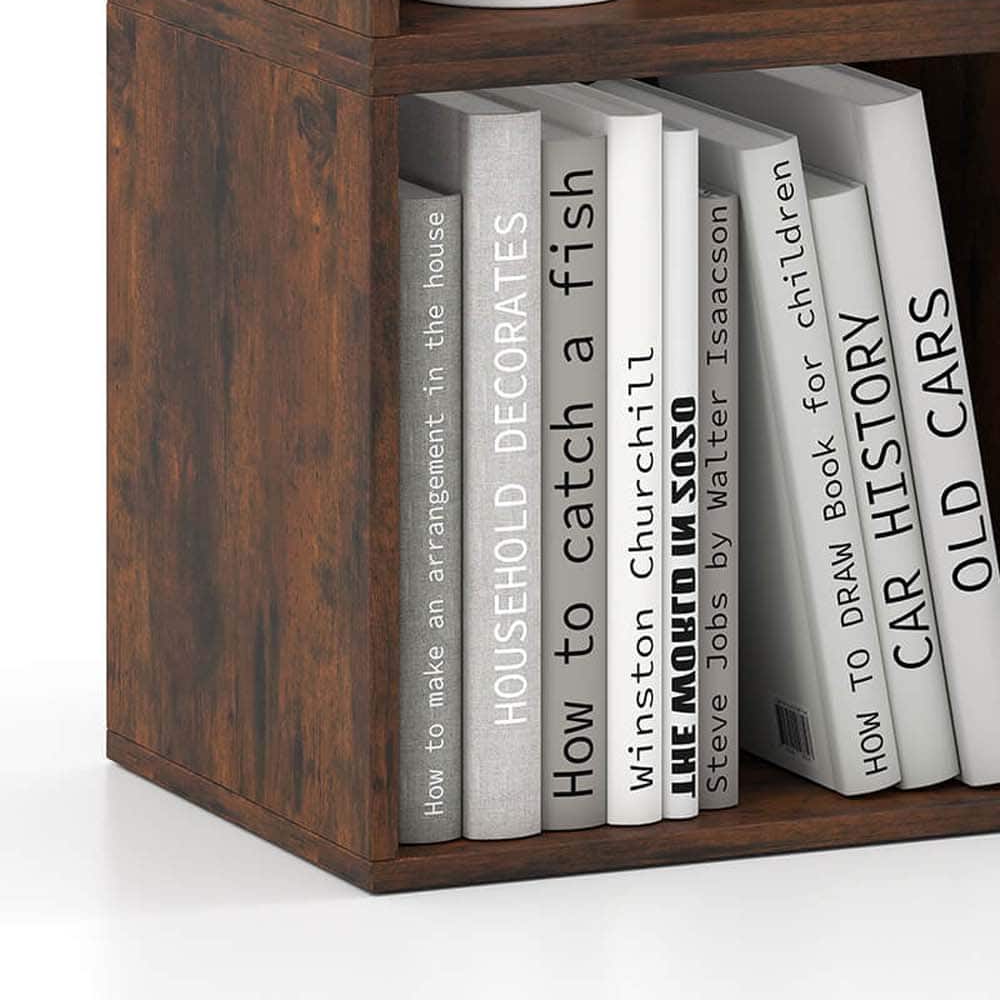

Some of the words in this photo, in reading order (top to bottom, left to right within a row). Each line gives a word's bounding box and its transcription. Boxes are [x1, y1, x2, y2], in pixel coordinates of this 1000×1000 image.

[423, 212, 444, 289] house
[550, 170, 594, 296] fish
[773, 160, 815, 328] children
[423, 304, 444, 349] the
[706, 206, 728, 365] Isaacson
[494, 211, 528, 453] DECORATES
[563, 336, 594, 362] a
[909, 288, 968, 438] CARS
[423, 366, 444, 396] in
[802, 355, 828, 413] for
[839, 312, 914, 539] HISTORY
[550, 402, 594, 563] catch
[628, 347, 654, 579] Churchill
[705, 390, 728, 510] Walter
[812, 435, 846, 521] Book
[424, 413, 448, 582] arrangement
[940, 479, 993, 592] OLD
[704, 532, 732, 569] by
[828, 543, 864, 627] DRAW
[428, 599, 444, 629] an
[494, 483, 528, 725] HOUSEHOLD
[554, 603, 593, 664] to
[705, 593, 728, 669] Jobs
[883, 569, 933, 669] CAR
[423, 645, 444, 708] make
[628, 608, 654, 791] Winston
[846, 648, 873, 692] TO
[425, 723, 444, 752] to
[552, 702, 593, 797] How
[706, 694, 728, 792] Steve
[856, 711, 888, 775] HOW
[424, 769, 444, 816] How
